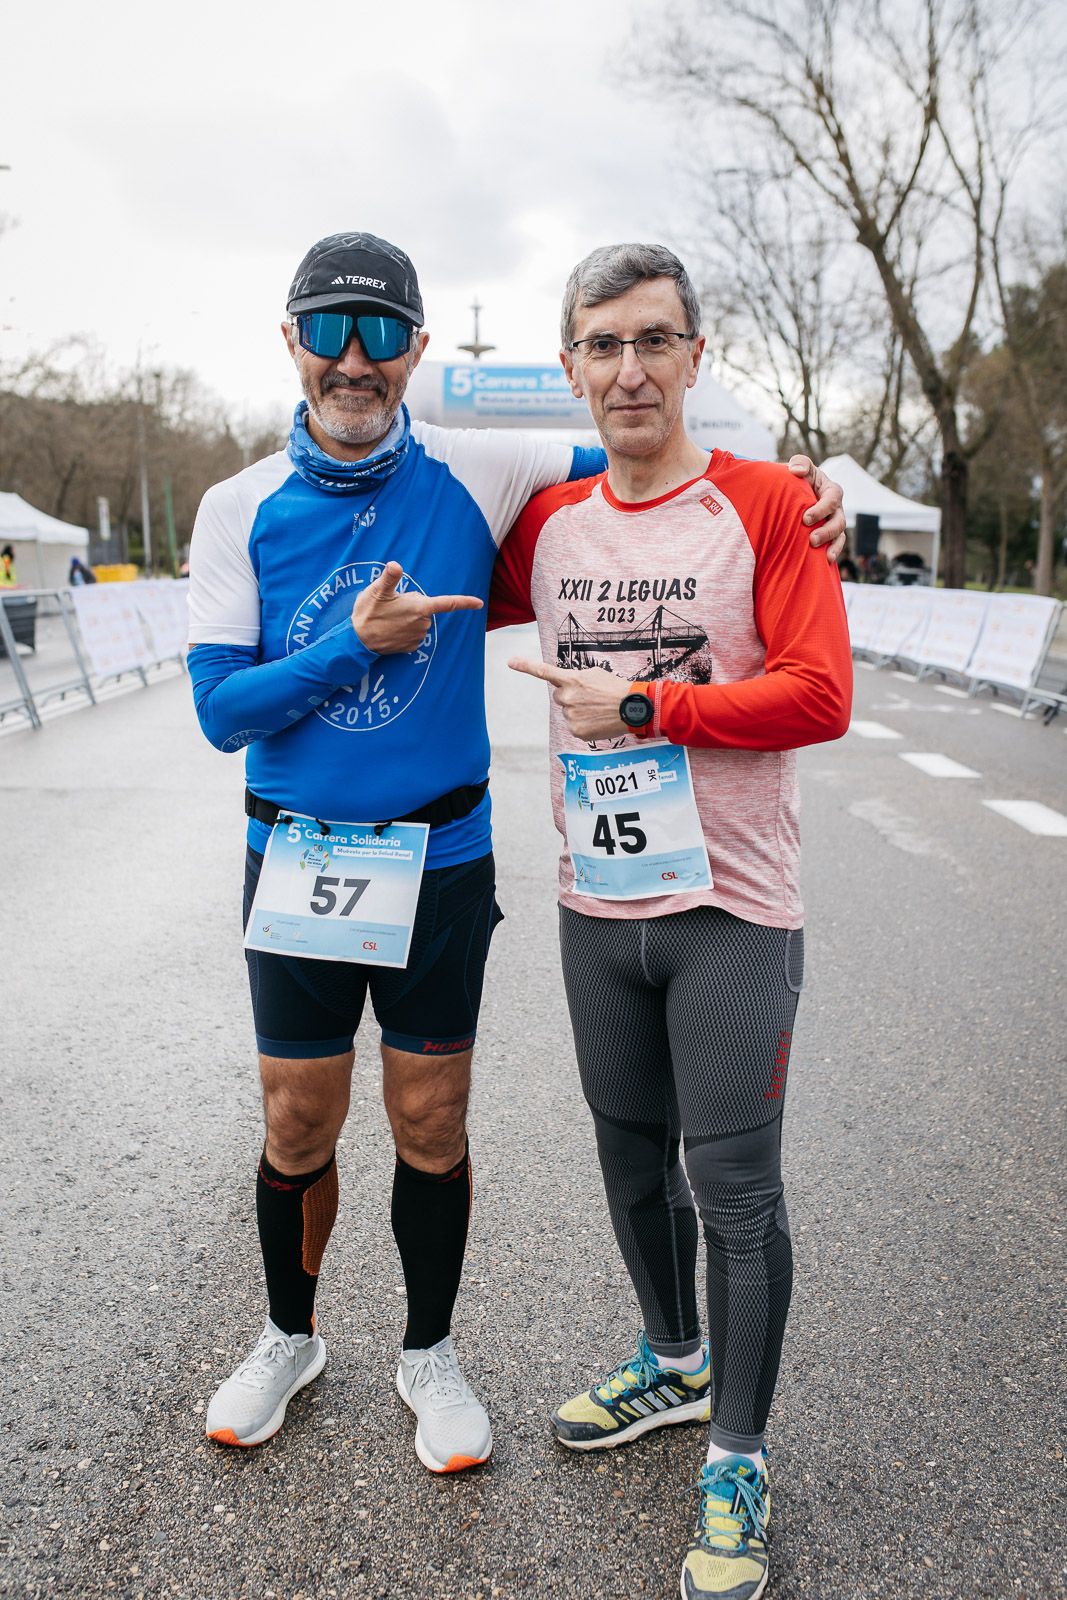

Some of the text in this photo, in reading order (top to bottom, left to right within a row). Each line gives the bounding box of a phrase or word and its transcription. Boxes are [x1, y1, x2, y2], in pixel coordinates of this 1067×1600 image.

[345, 275, 387, 291] TERREX
[307, 568, 364, 610] TRAIL
[558, 577, 697, 602] XXII 2 LEGUAS
[596, 607, 636, 623] 2023
[330, 699, 391, 725] 2015
[595, 772, 639, 796] 0021
[647, 769, 656, 781] 5K
[305, 829, 348, 844] Carrera
[351, 834, 401, 846] Solidaria
[592, 811, 647, 855] 45
[661, 871, 678, 881] CSL
[310, 875, 371, 917] 57
[362, 941, 378, 951] CSL
